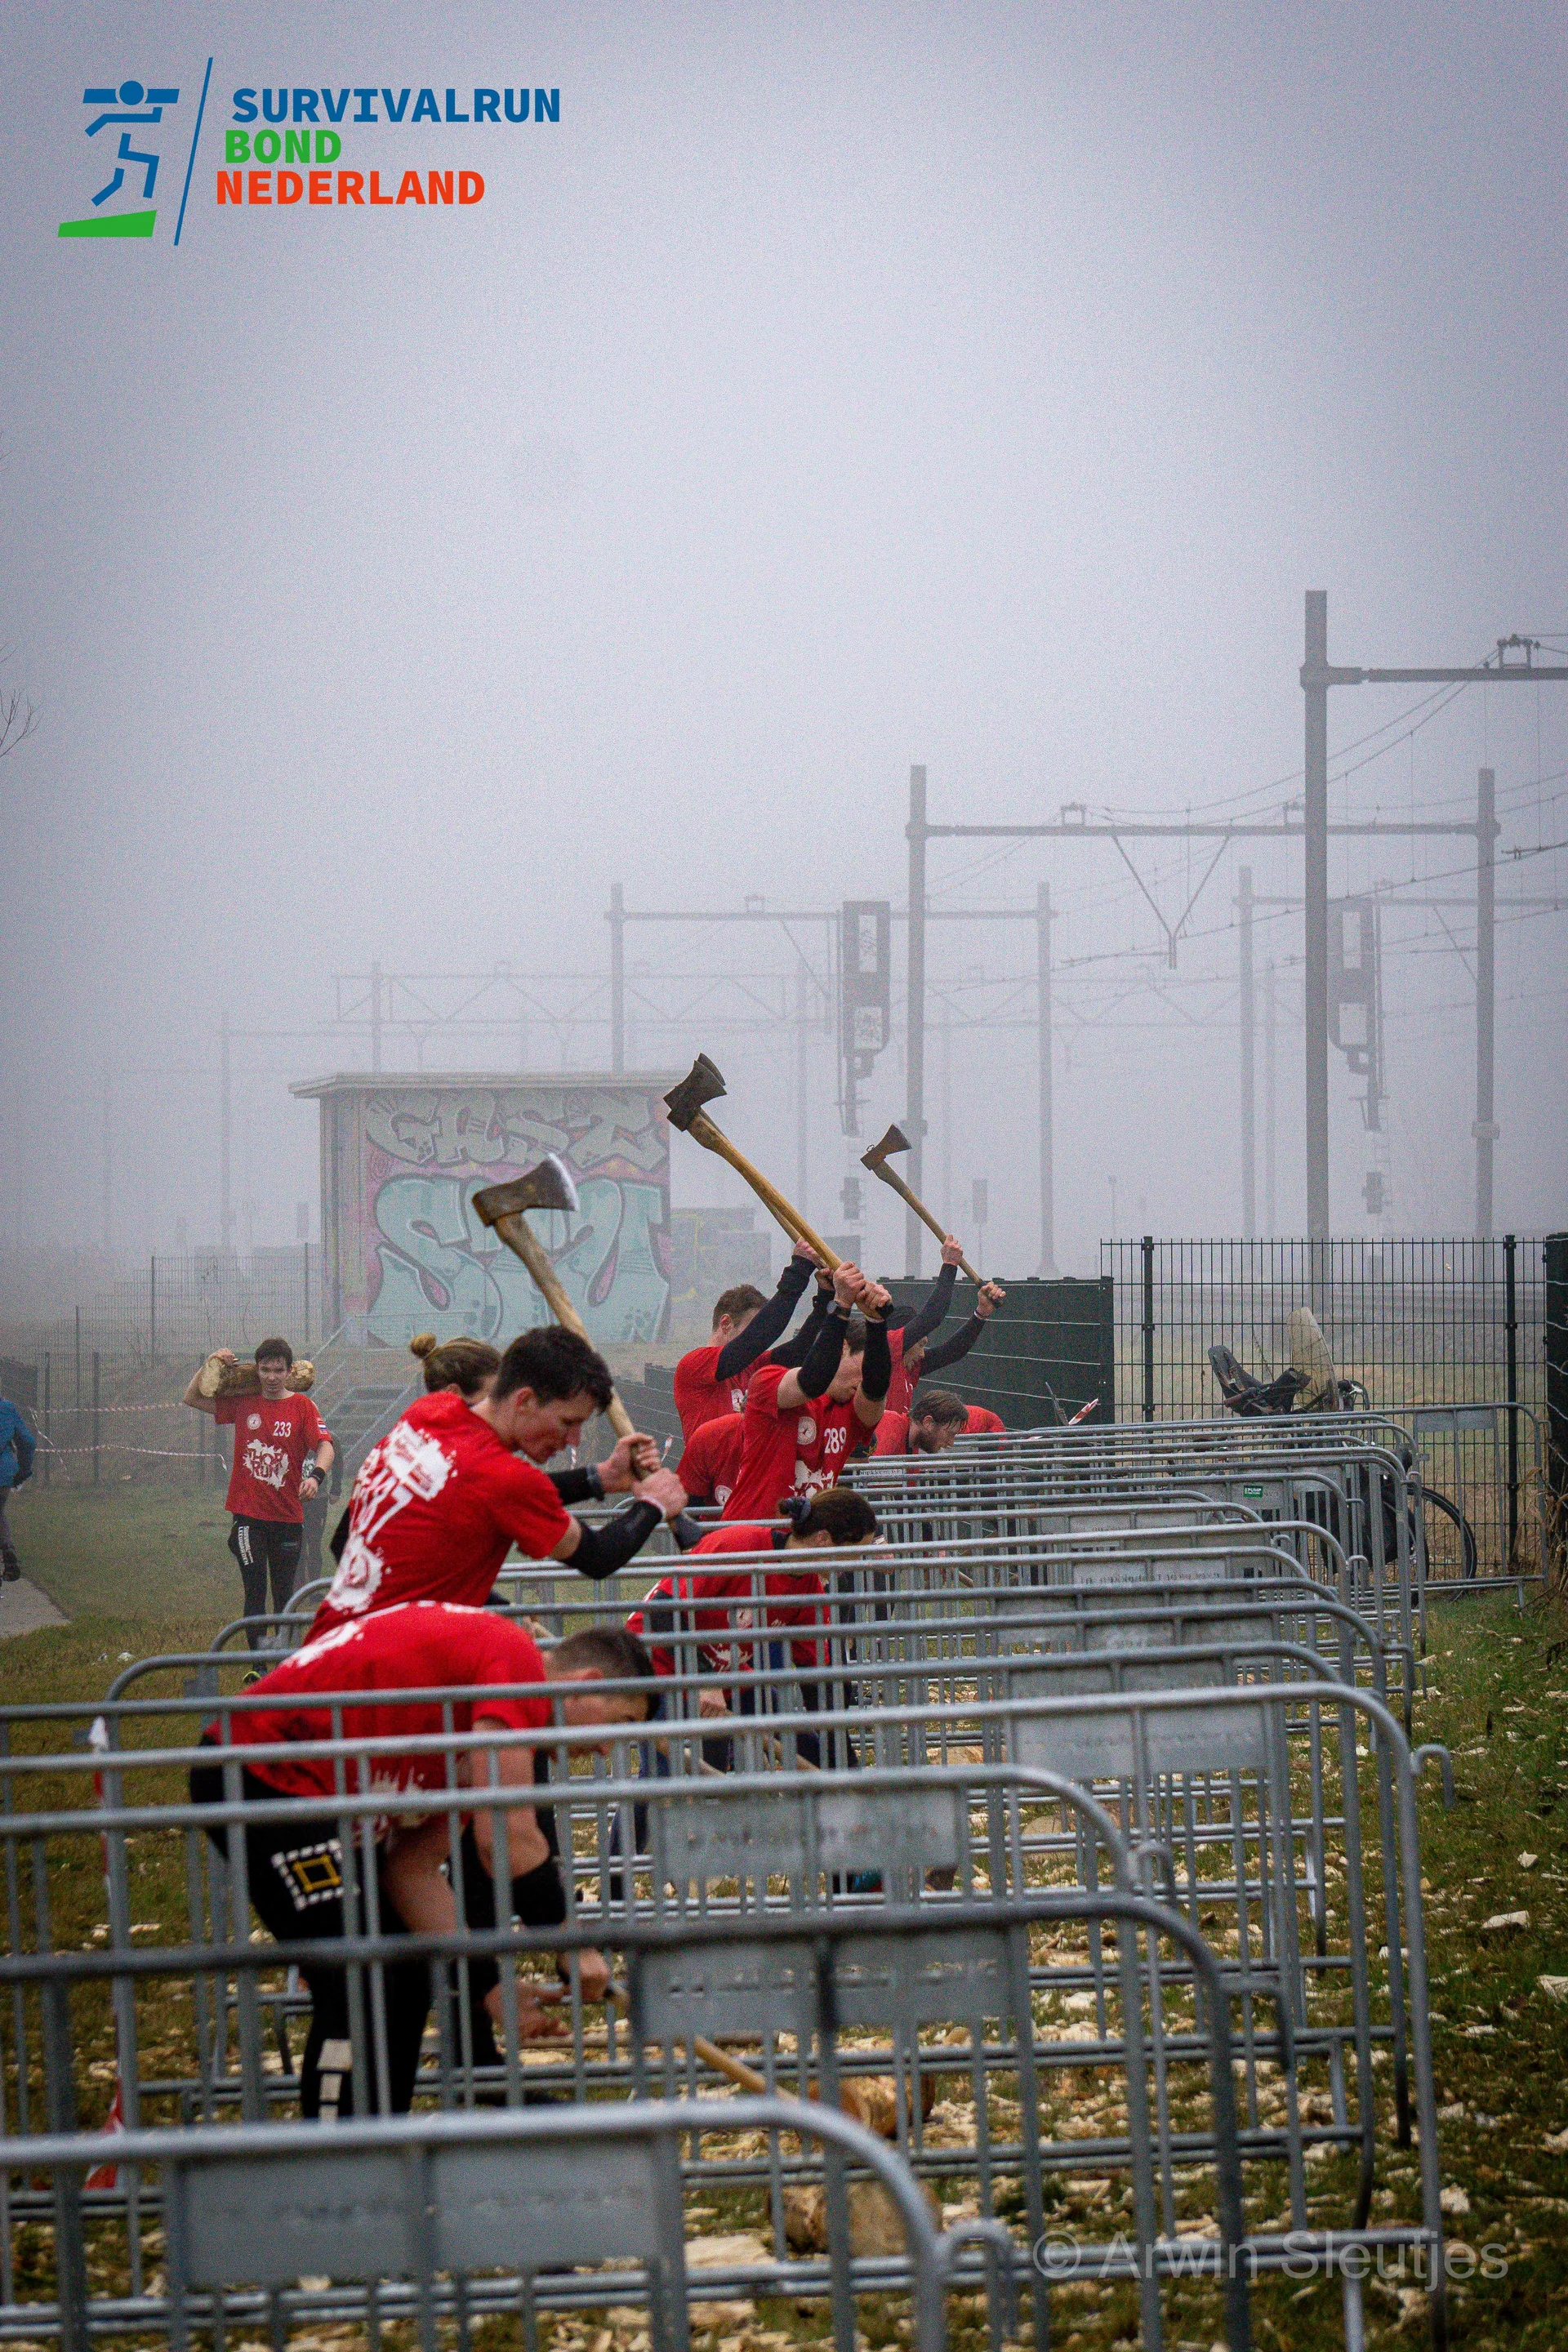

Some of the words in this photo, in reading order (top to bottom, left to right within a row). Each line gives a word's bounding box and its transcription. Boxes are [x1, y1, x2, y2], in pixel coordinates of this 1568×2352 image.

[273, 1421, 292, 1437] 233
[824, 1427, 846, 1454] 289
[238, 1526, 249, 1566] LEEUWARDEN
